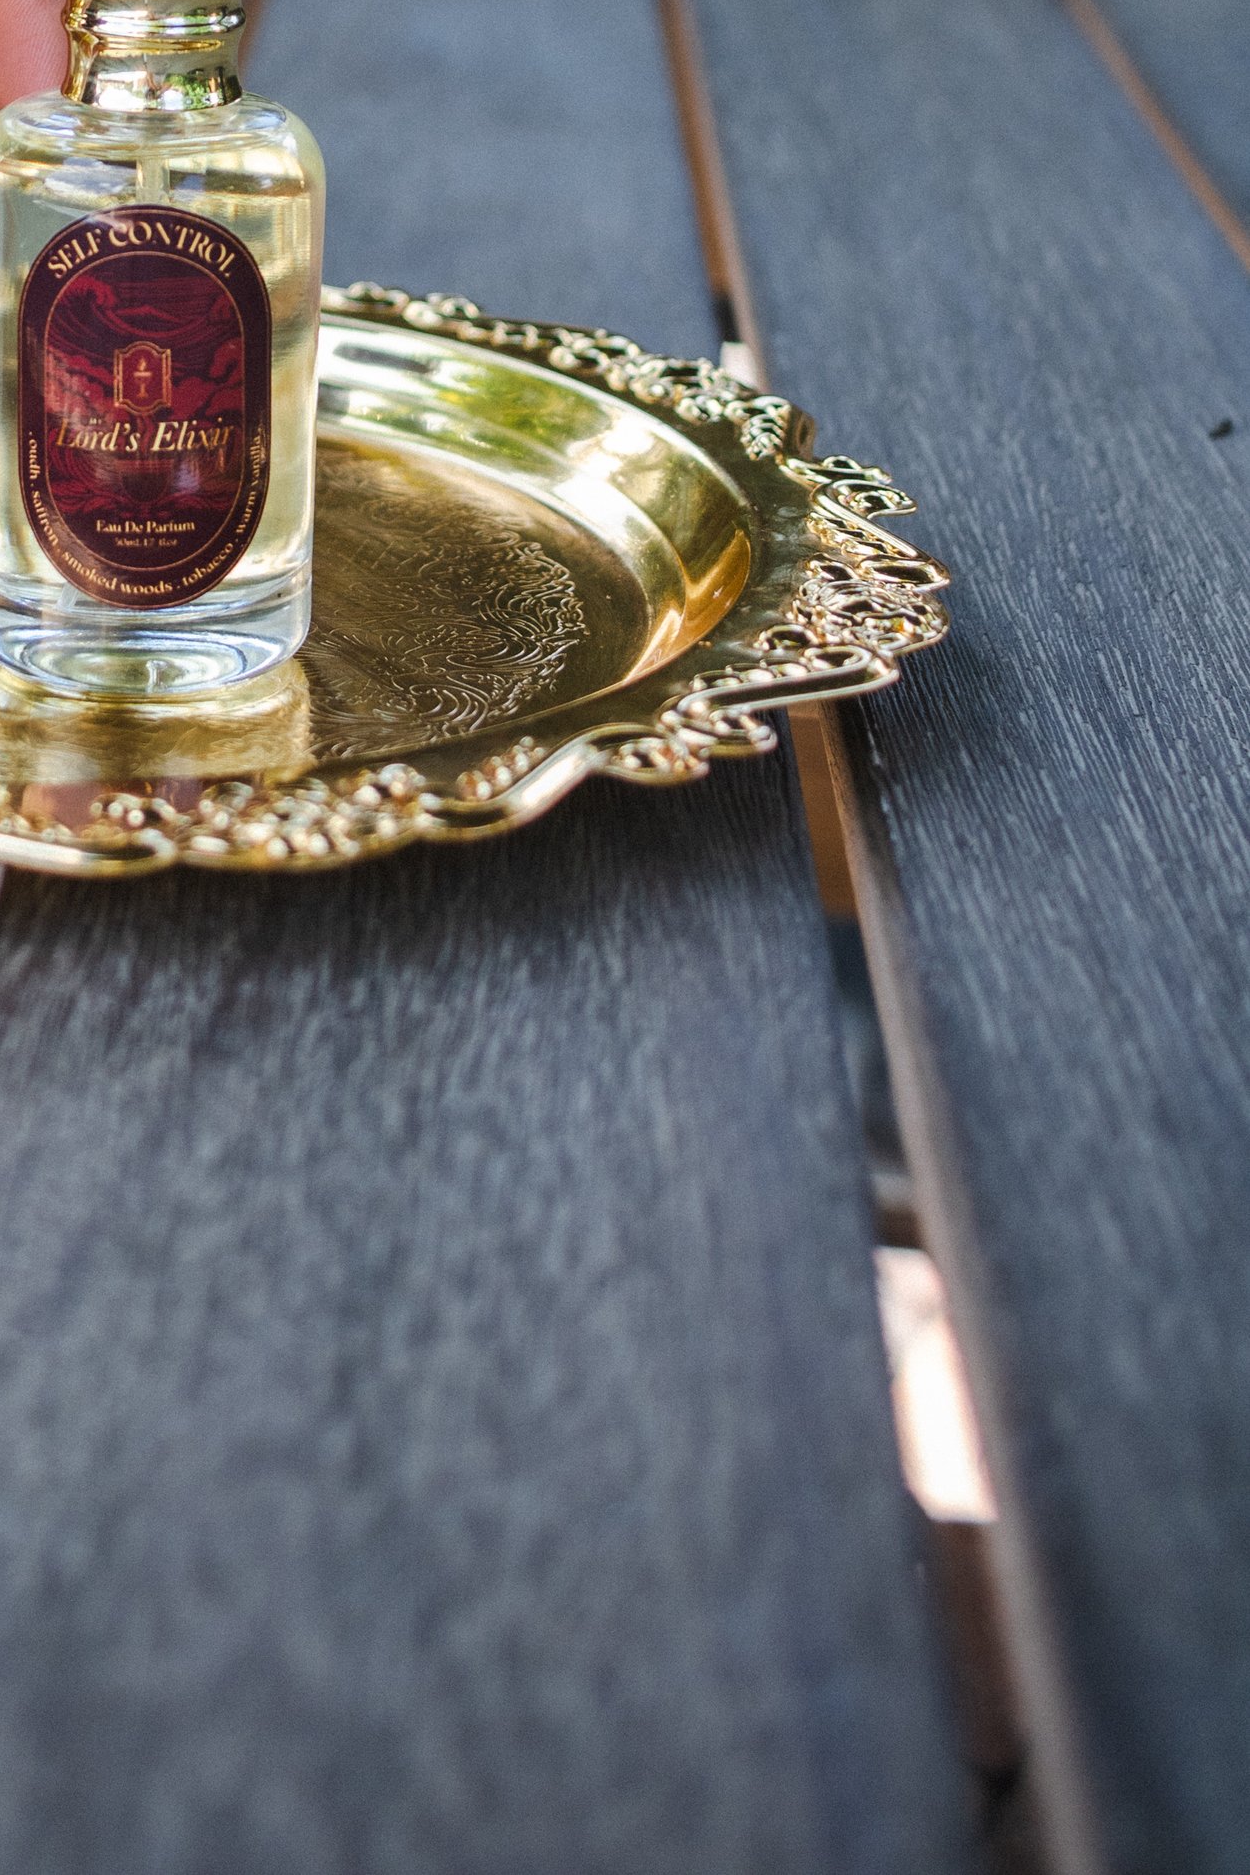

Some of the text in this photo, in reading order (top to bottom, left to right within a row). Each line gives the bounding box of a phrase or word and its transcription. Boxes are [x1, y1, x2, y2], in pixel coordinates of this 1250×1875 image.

[48, 221, 236, 279] SELF CONTROL
[151, 417, 235, 452] Elixir
[28, 435, 262, 594] oudh saffron smoked woods tobacco warm vanilla
[96, 519, 196, 534] Eau De Parfum
